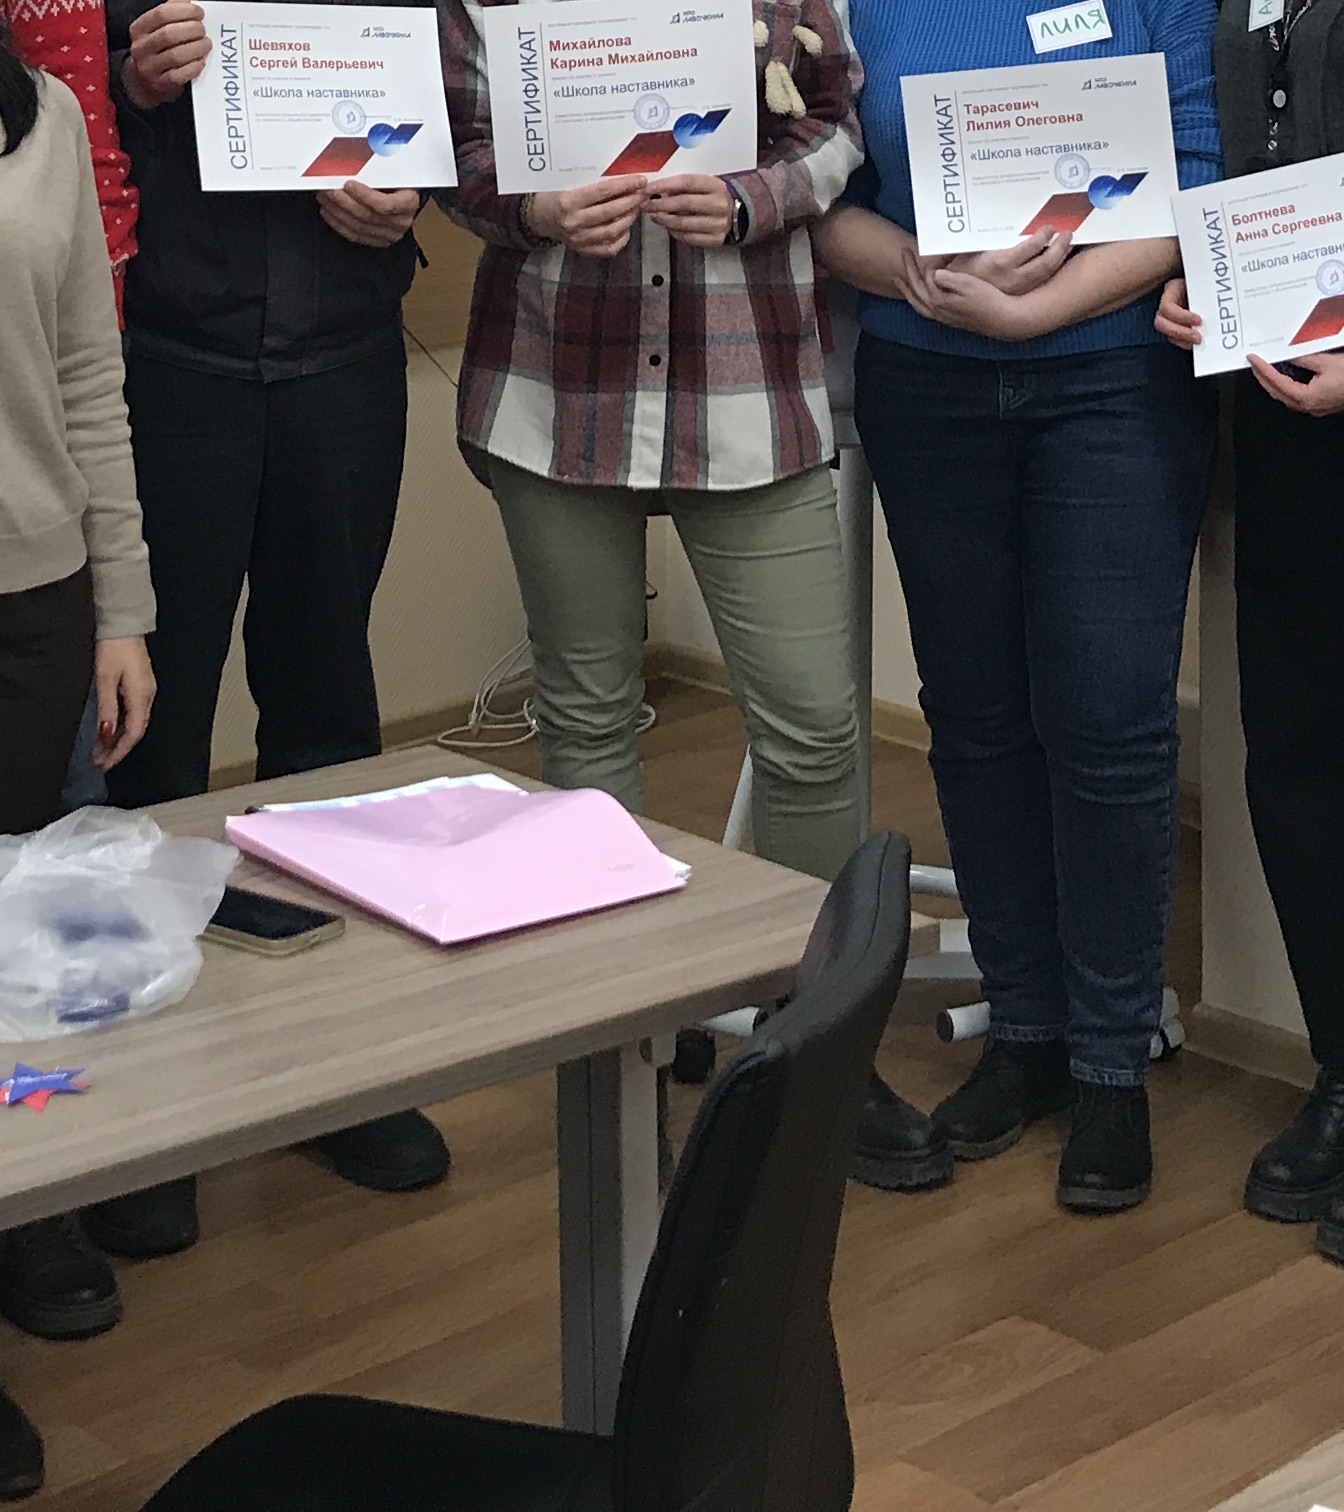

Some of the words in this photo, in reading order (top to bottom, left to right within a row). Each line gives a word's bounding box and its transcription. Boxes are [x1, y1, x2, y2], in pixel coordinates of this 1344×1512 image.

[248, 38, 311, 51] Шевяхов
[549, 36, 632, 52] Михайлова
[249, 56, 298, 71] Сергей
[301, 58, 384, 72] Валерьевич
[549, 55, 604, 72] Карина
[608, 47, 698, 66] Михайловна
[220, 24, 248, 170] СЕРТИФИКАТ
[252, 86, 303, 99] «Школа
[306, 87, 386, 99] наставника»
[552, 84, 607, 98] «Школа
[610, 77, 696, 95] наставника»
[517, 26, 547, 172] СЕРТИФИКАТ
[963, 99, 1040, 116] Тарасевич
[965, 118, 1011, 133] Лилия
[1014, 111, 1084, 128] Олеговна
[970, 147, 1022, 162] «Школа
[1025, 140, 1110, 157] наставника»
[933, 94, 965, 234] СЕРТИФИКАТ
[1231, 202, 1296, 227] Болтнева
[1235, 224, 1269, 244] Анна
[1272, 210, 1343, 236] Сергеевна
[1241, 255, 1290, 274] «Школа
[1202, 207, 1239, 350] СЕРТИФИКАТ
